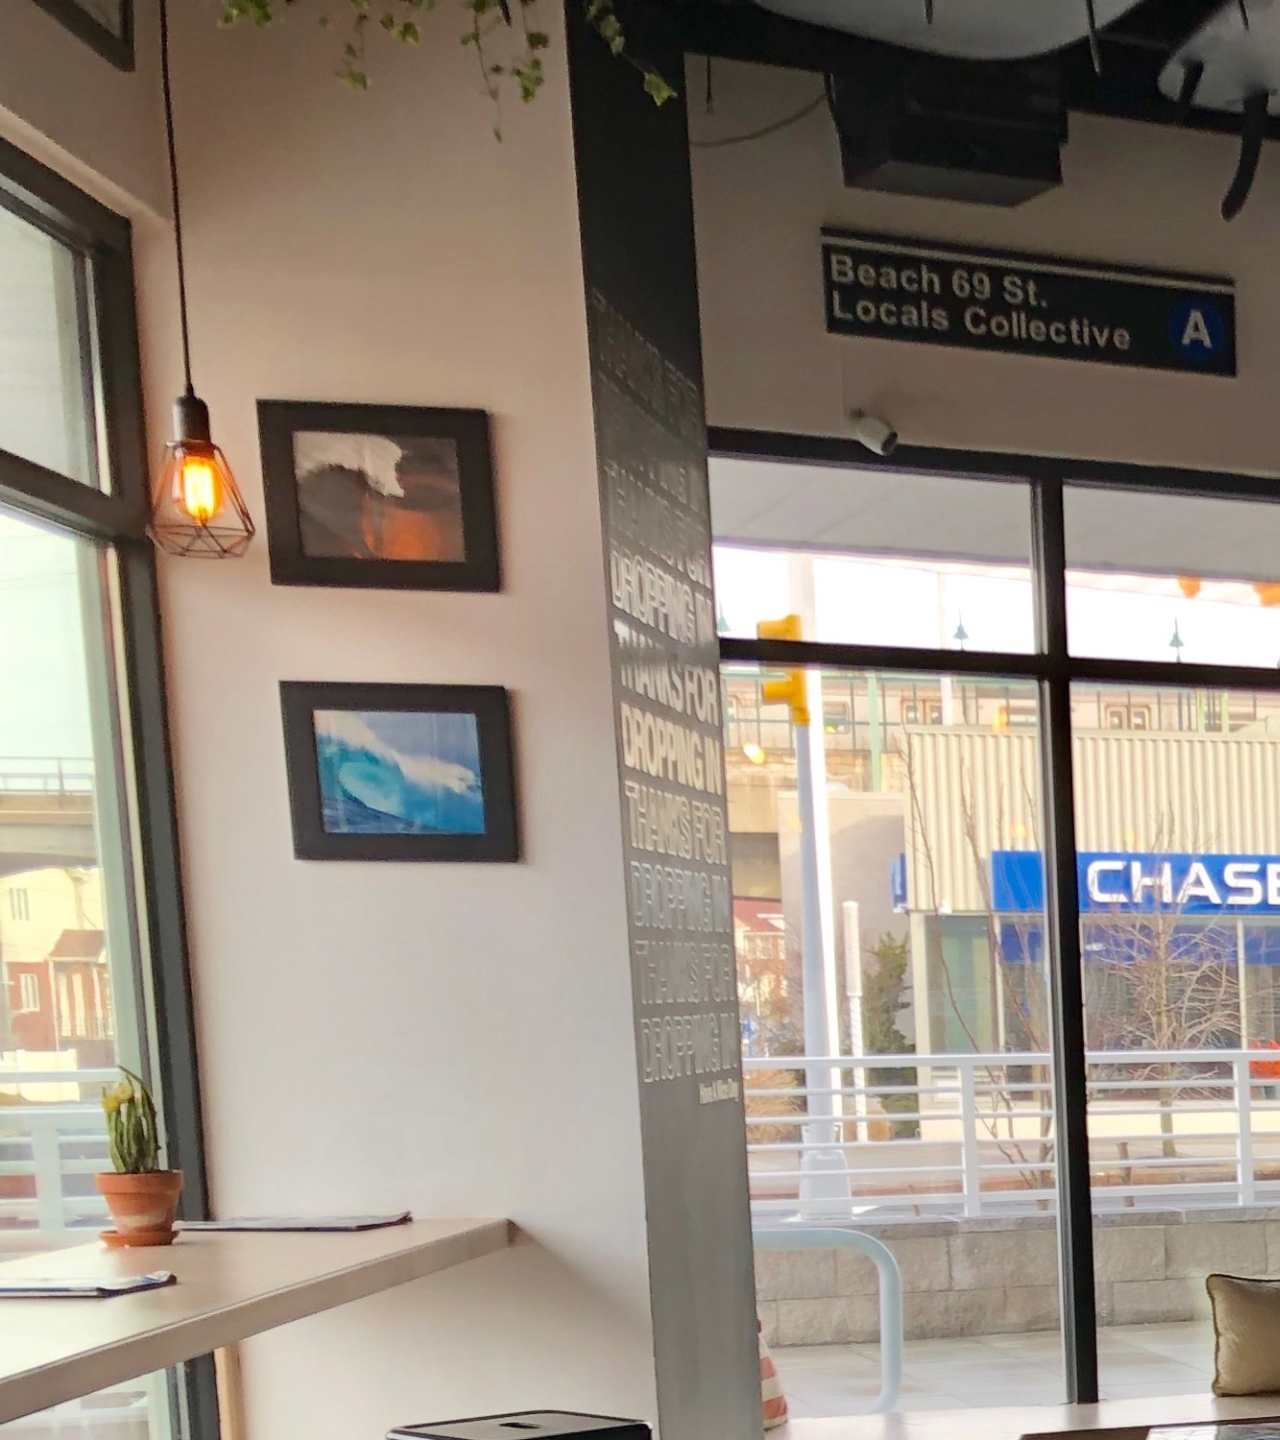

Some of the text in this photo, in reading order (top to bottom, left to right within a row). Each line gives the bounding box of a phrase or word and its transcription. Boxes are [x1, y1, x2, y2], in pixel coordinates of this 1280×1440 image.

[831, 254, 1048, 308] Beach 69 St.
[832, 290, 1131, 351] Locals Collective
[1181, 309, 1212, 349] A
[621, 702, 722, 795] DROPPING IN
[625, 780, 727, 865] THANKS FOR
[640, 1014, 719, 1082] DROPPING
